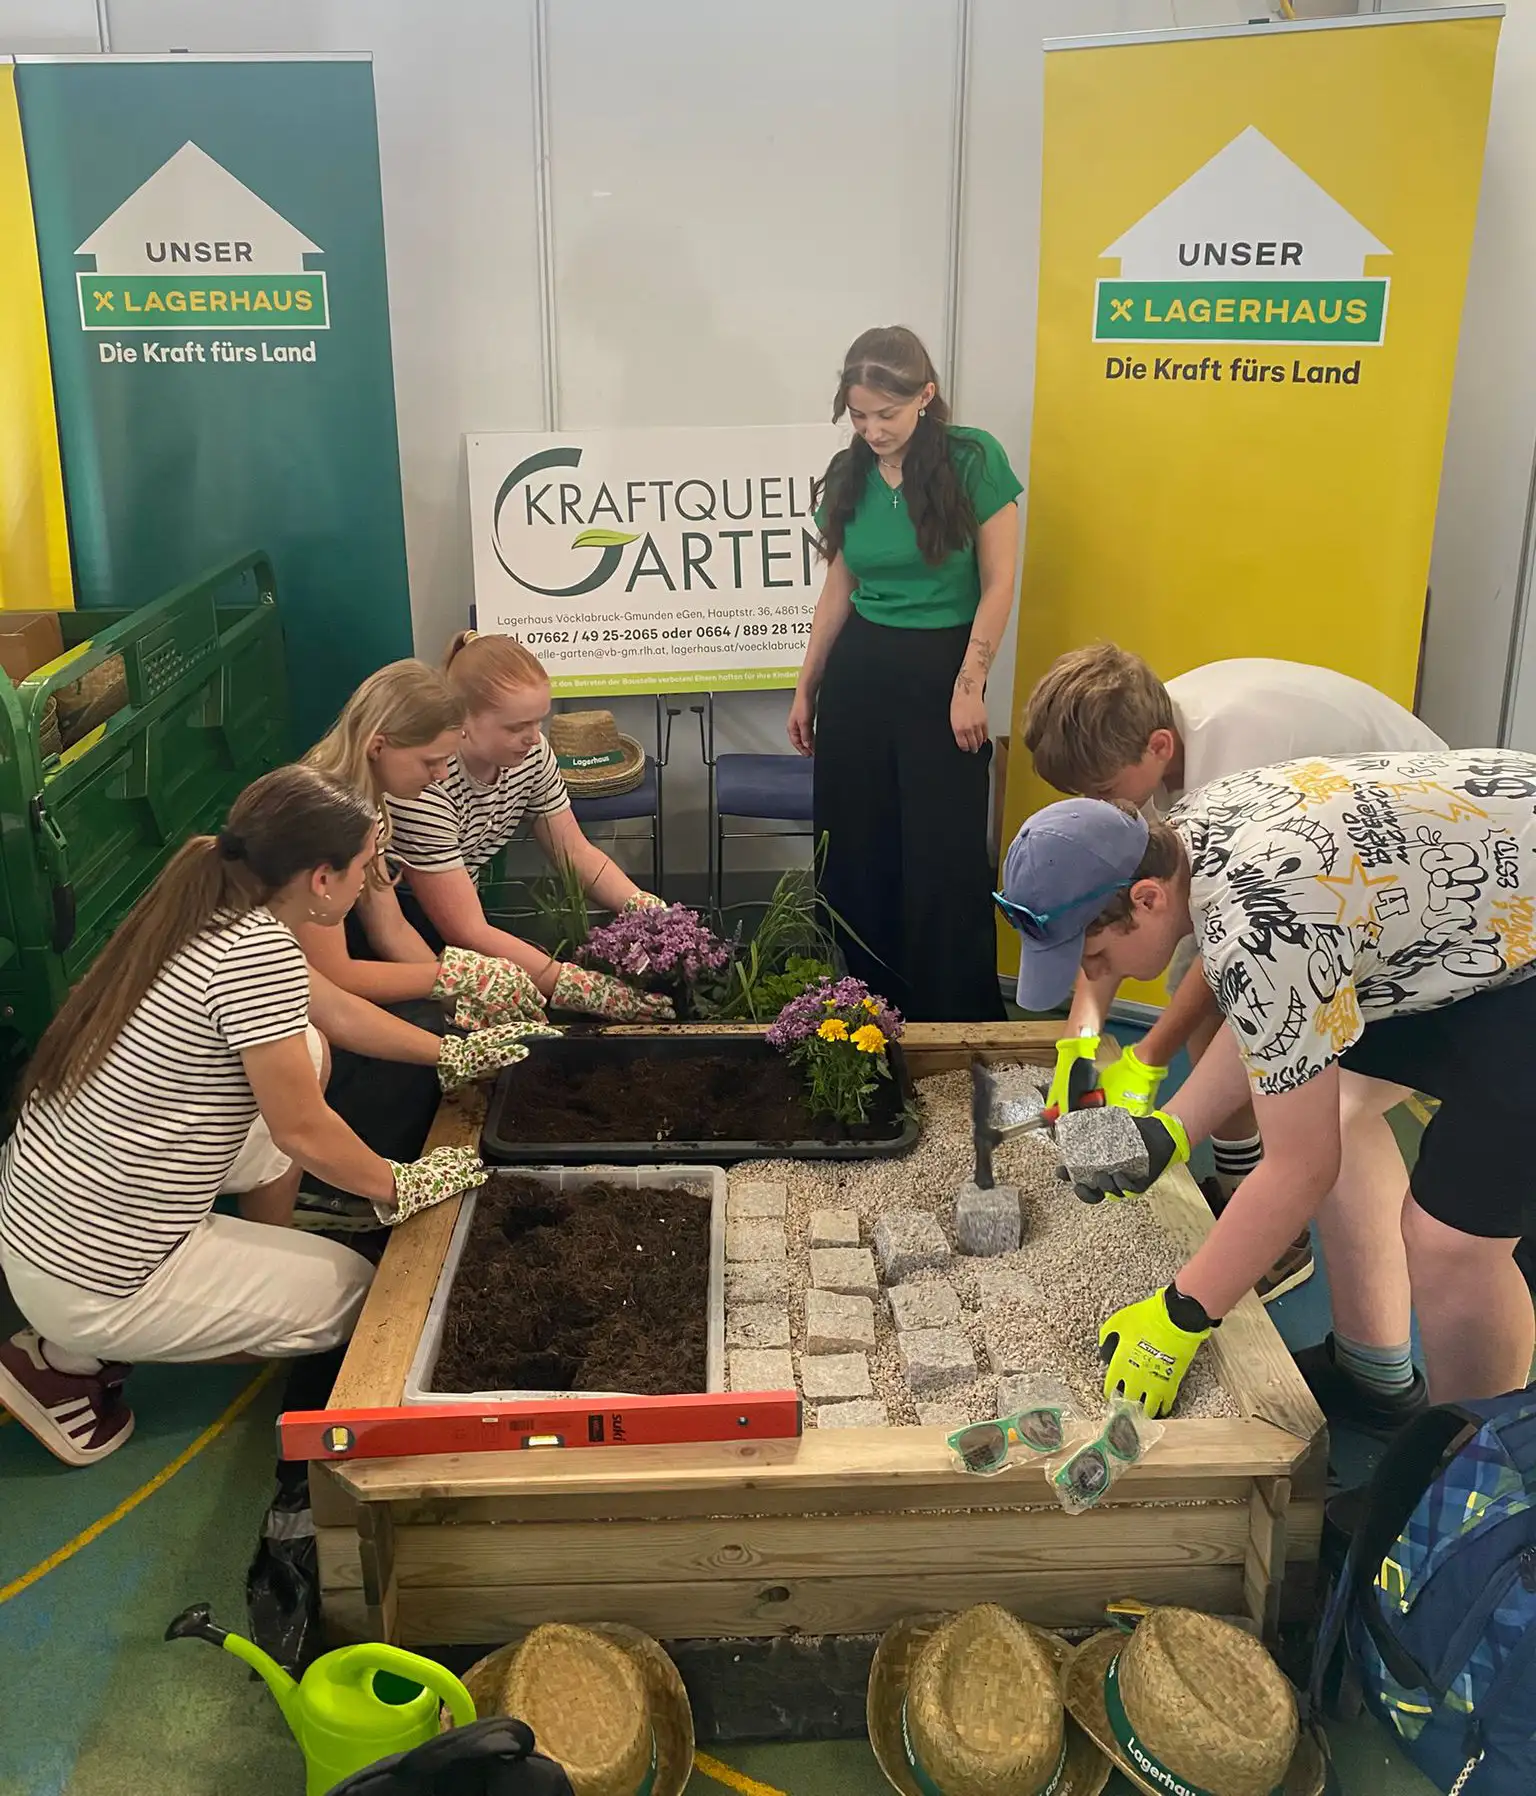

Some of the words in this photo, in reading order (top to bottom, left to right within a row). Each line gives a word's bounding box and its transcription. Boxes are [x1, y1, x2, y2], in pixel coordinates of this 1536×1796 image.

[146, 241, 253, 263] UNSER
[1178, 242, 1304, 267] UNSER
[124, 290, 313, 312] LAGERHAUS
[1144, 299, 1368, 324] LAGERHAUS
[99, 343, 137, 363] Die
[143, 341, 206, 363] Kraft
[211, 341, 257, 363] fürs
[262, 341, 316, 363] Land
[1105, 357, 1147, 380] Die
[1154, 357, 1222, 382] Kraft
[1230, 358, 1285, 383] fürs
[1292, 360, 1361, 385] Land
[524, 476, 816, 526] KRAFTQUELL
[497, 615, 553, 627] Lagerhaus
[556, 610, 674, 624] Vöcklabruck-Gmunden
[676, 608, 705, 620] eGen,
[708, 607, 755, 619] Hauptstr.
[757, 606, 773, 617] 36,
[775, 605, 799, 616] 4861
[527, 631, 569, 644] 07662
[572, 630, 579, 644] /
[581, 630, 599, 642] 49
[603, 628, 658, 641] 25-2065
[662, 627, 693, 639] oder
[696, 625, 731, 638] 0664
[734, 624, 740, 638] /
[743, 624, 768, 636] 889
[771, 623, 788, 635] 28
[790, 622, 812, 634] 123
[535, 646, 669, 660] elle-garten@vb-gm.rlh.at,
[671, 640, 806, 656] lagerhaus.at/voecklabruck
[572, 755, 610, 767] Lagerhaus
[612, 1413, 626, 1441] suki
[1127, 1736, 1197, 1796] Lagerhau
